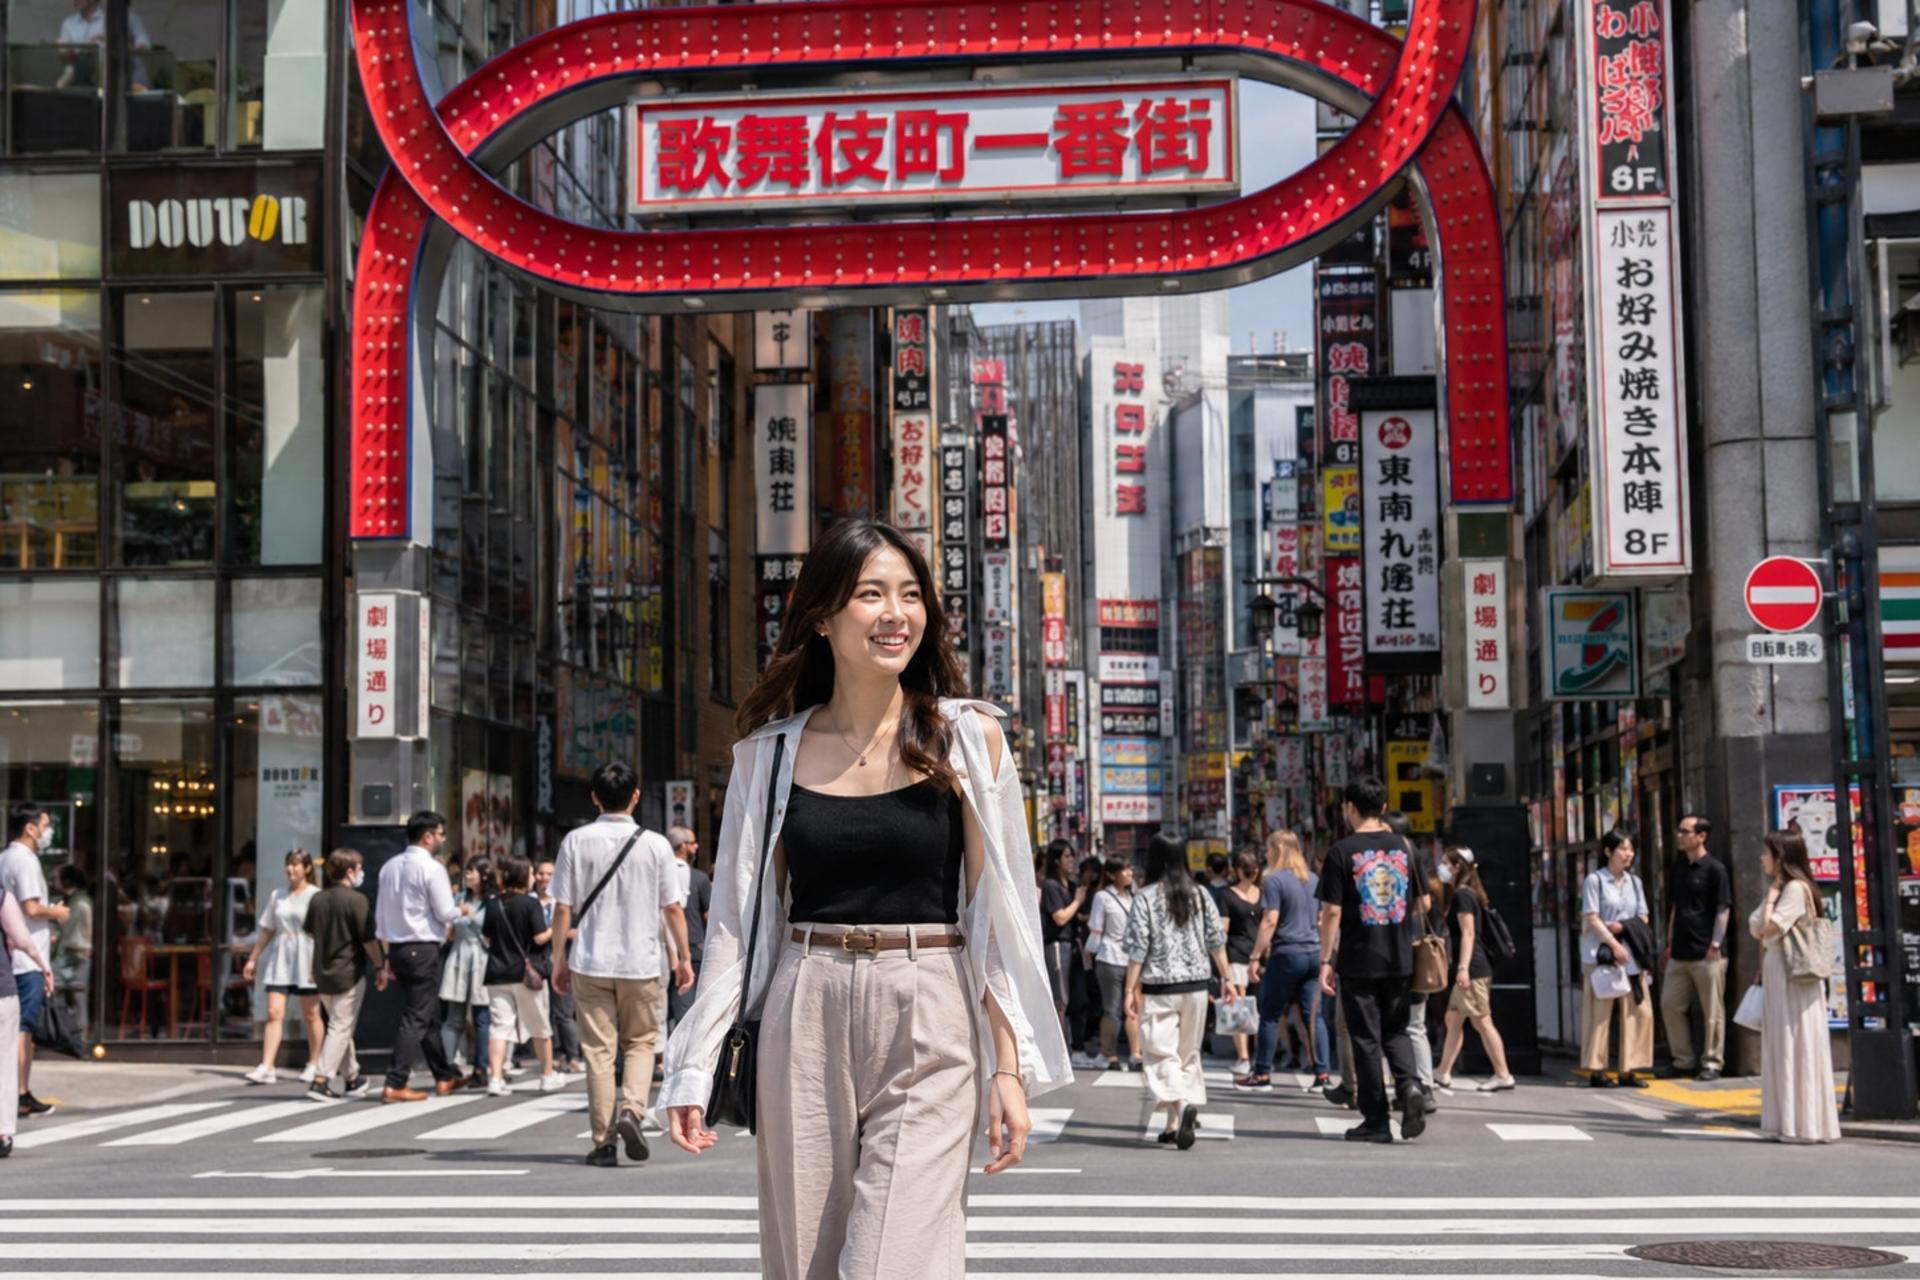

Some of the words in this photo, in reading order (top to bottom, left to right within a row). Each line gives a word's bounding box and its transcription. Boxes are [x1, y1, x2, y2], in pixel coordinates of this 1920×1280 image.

[656, 98, 1212, 193] 歌舞伎町一番街
[1611, 166, 1656, 192] 6F
[129, 194, 307, 249] DOUTOR
[1616, 257, 1664, 515] お好み焼き本陣
[1624, 529, 1669, 555] 8F
[366, 605, 388, 725] 劇場通り
[1473, 573, 1498, 695] 劇場通り
